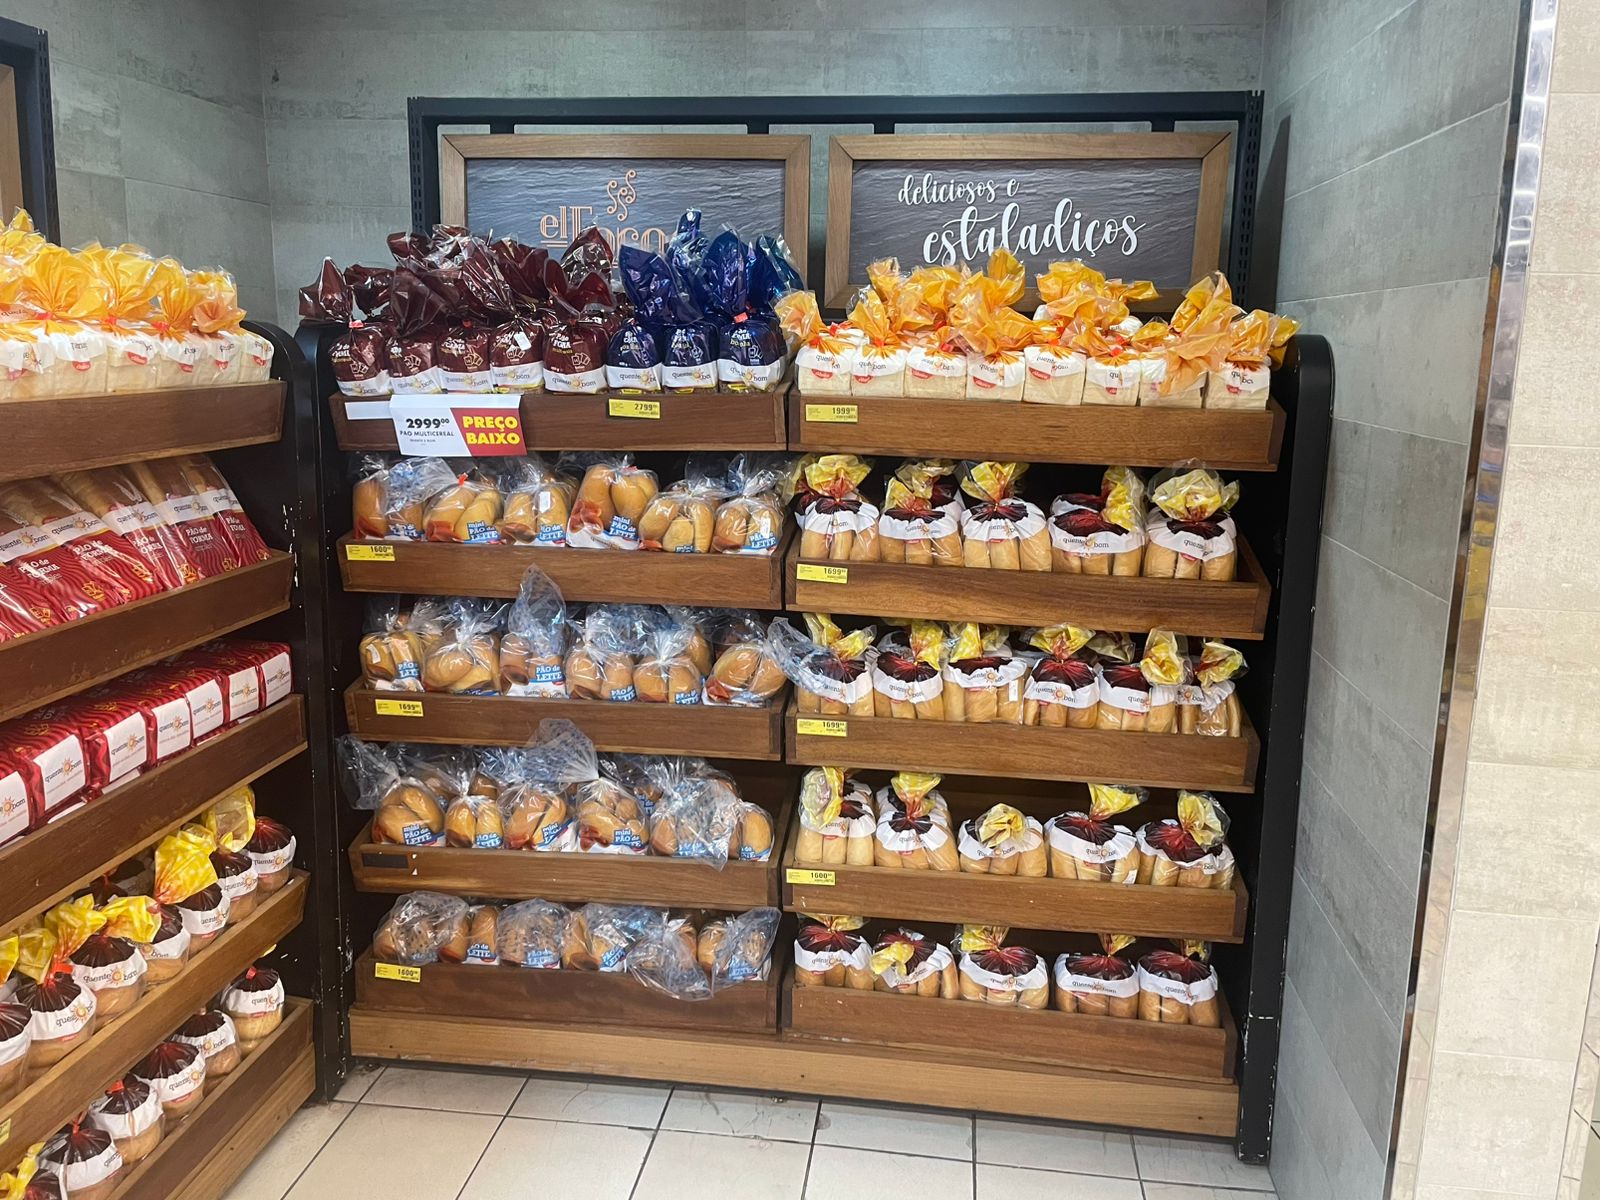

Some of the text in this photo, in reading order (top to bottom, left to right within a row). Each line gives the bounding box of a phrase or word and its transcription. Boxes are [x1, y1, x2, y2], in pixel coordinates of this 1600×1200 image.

[898, 173, 1019, 206] deliciosos e
[922, 198, 1147, 267] estaladiços
[406, 418, 440, 429] 2999
[462, 415, 518, 432] PREÇO
[465, 432, 521, 445] BAIXO
[468, 521, 485, 529] mini
[612, 520, 628, 530] PÃO
[613, 515, 631, 525] mini
[470, 530, 498, 541] LEITE
[610, 527, 636, 539] LEITE
[824, 567, 842, 575] 1699
[536, 665, 552, 673] PÃO
[536, 671, 562, 681] LEITE
[404, 831, 419, 839] PÃO
[405, 832, 432, 845] LEITE
[467, 949, 491, 958] LEITE
